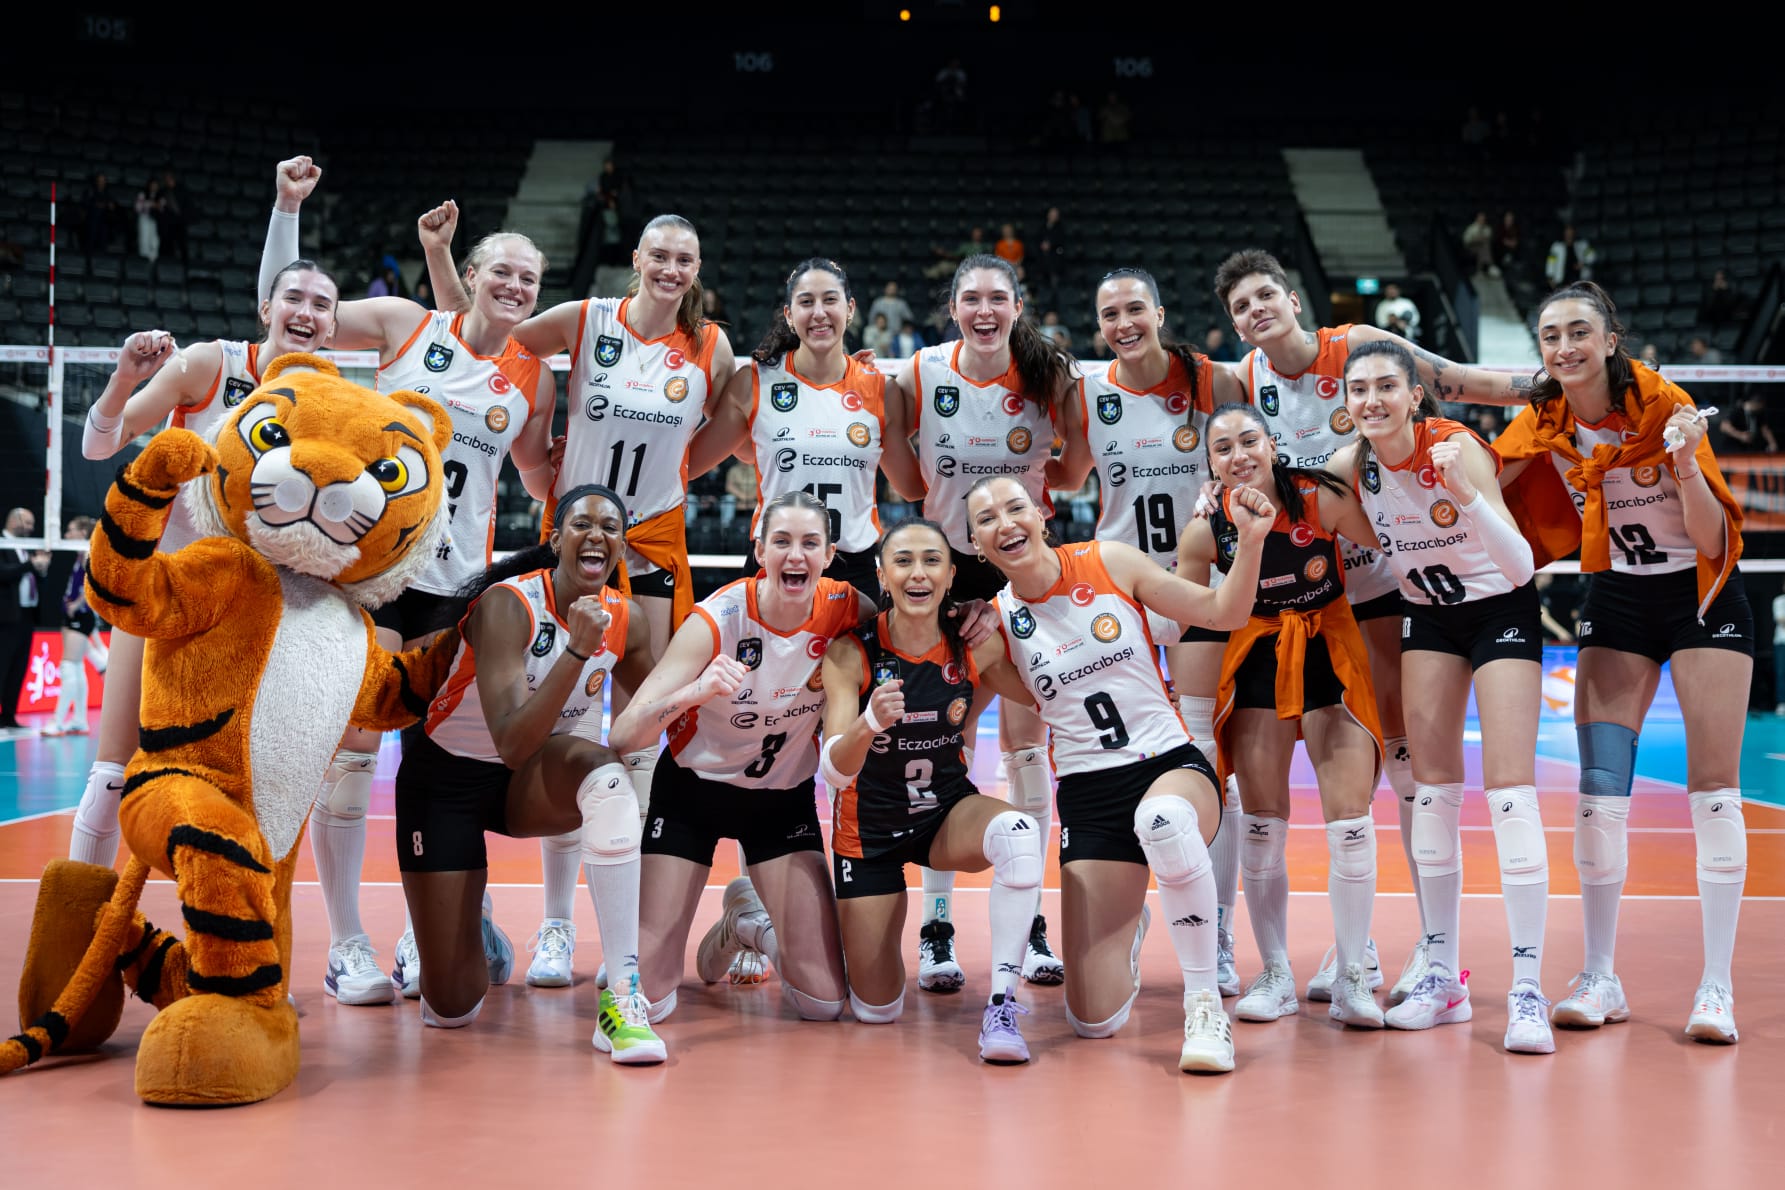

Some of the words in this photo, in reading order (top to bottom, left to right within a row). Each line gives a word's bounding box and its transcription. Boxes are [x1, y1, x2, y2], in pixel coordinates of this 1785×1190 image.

[85, 17, 127, 40] 105
[735, 52, 774, 72] 106
[1113, 57, 1152, 77] 106
[613, 404, 683, 427] Eczacıbaşı
[452, 431, 498, 457] acıbaşı
[607, 440, 647, 497] 11
[802, 483, 842, 541] 5
[1132, 493, 1178, 554] 19
[1396, 532, 1468, 552] Eczacıbaşı
[1609, 523, 1668, 565] 12
[1344, 551, 1374, 571] avit
[1407, 563, 1466, 606] 10
[1058, 646, 1134, 686] Eczacıbaşı
[1084, 691, 1130, 750] 9
[744, 731, 787, 779] 3
[904, 758, 940, 815] 2
[652, 817, 664, 838] 3
[412, 831, 424, 856] 8
[842, 858, 853, 882] 2
